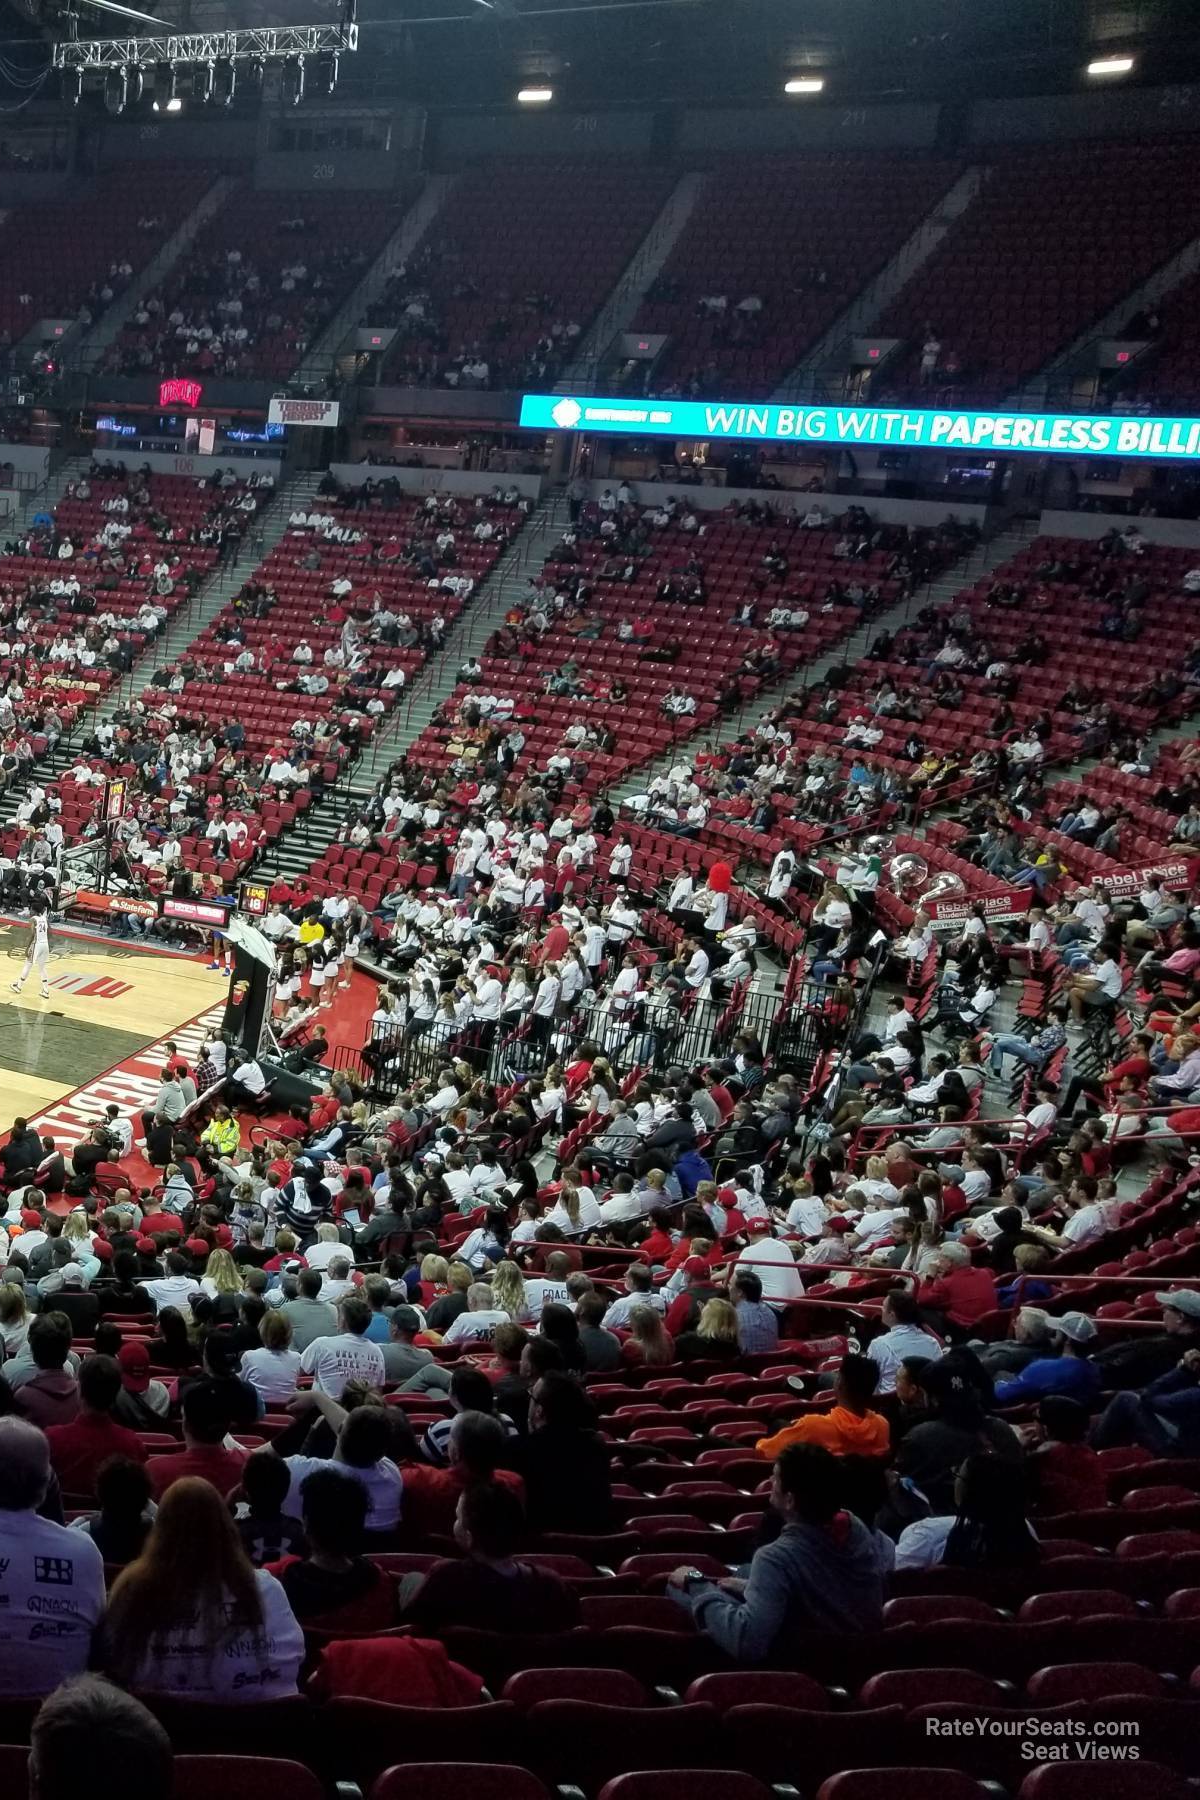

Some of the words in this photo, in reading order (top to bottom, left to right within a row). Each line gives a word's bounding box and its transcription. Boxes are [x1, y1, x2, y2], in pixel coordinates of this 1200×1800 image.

[312, 164, 335, 178] 209
[705, 406, 769, 435] WIN
[776, 409, 828, 438] BIG
[836, 411, 925, 441] WITH
[929, 415, 1112, 451] PAPERLESS
[1116, 421, 1200, 454] BILLI
[250, 898, 261, 911] 18
[937, 910, 968, 920] Student
[38, 923, 47, 933] 24
